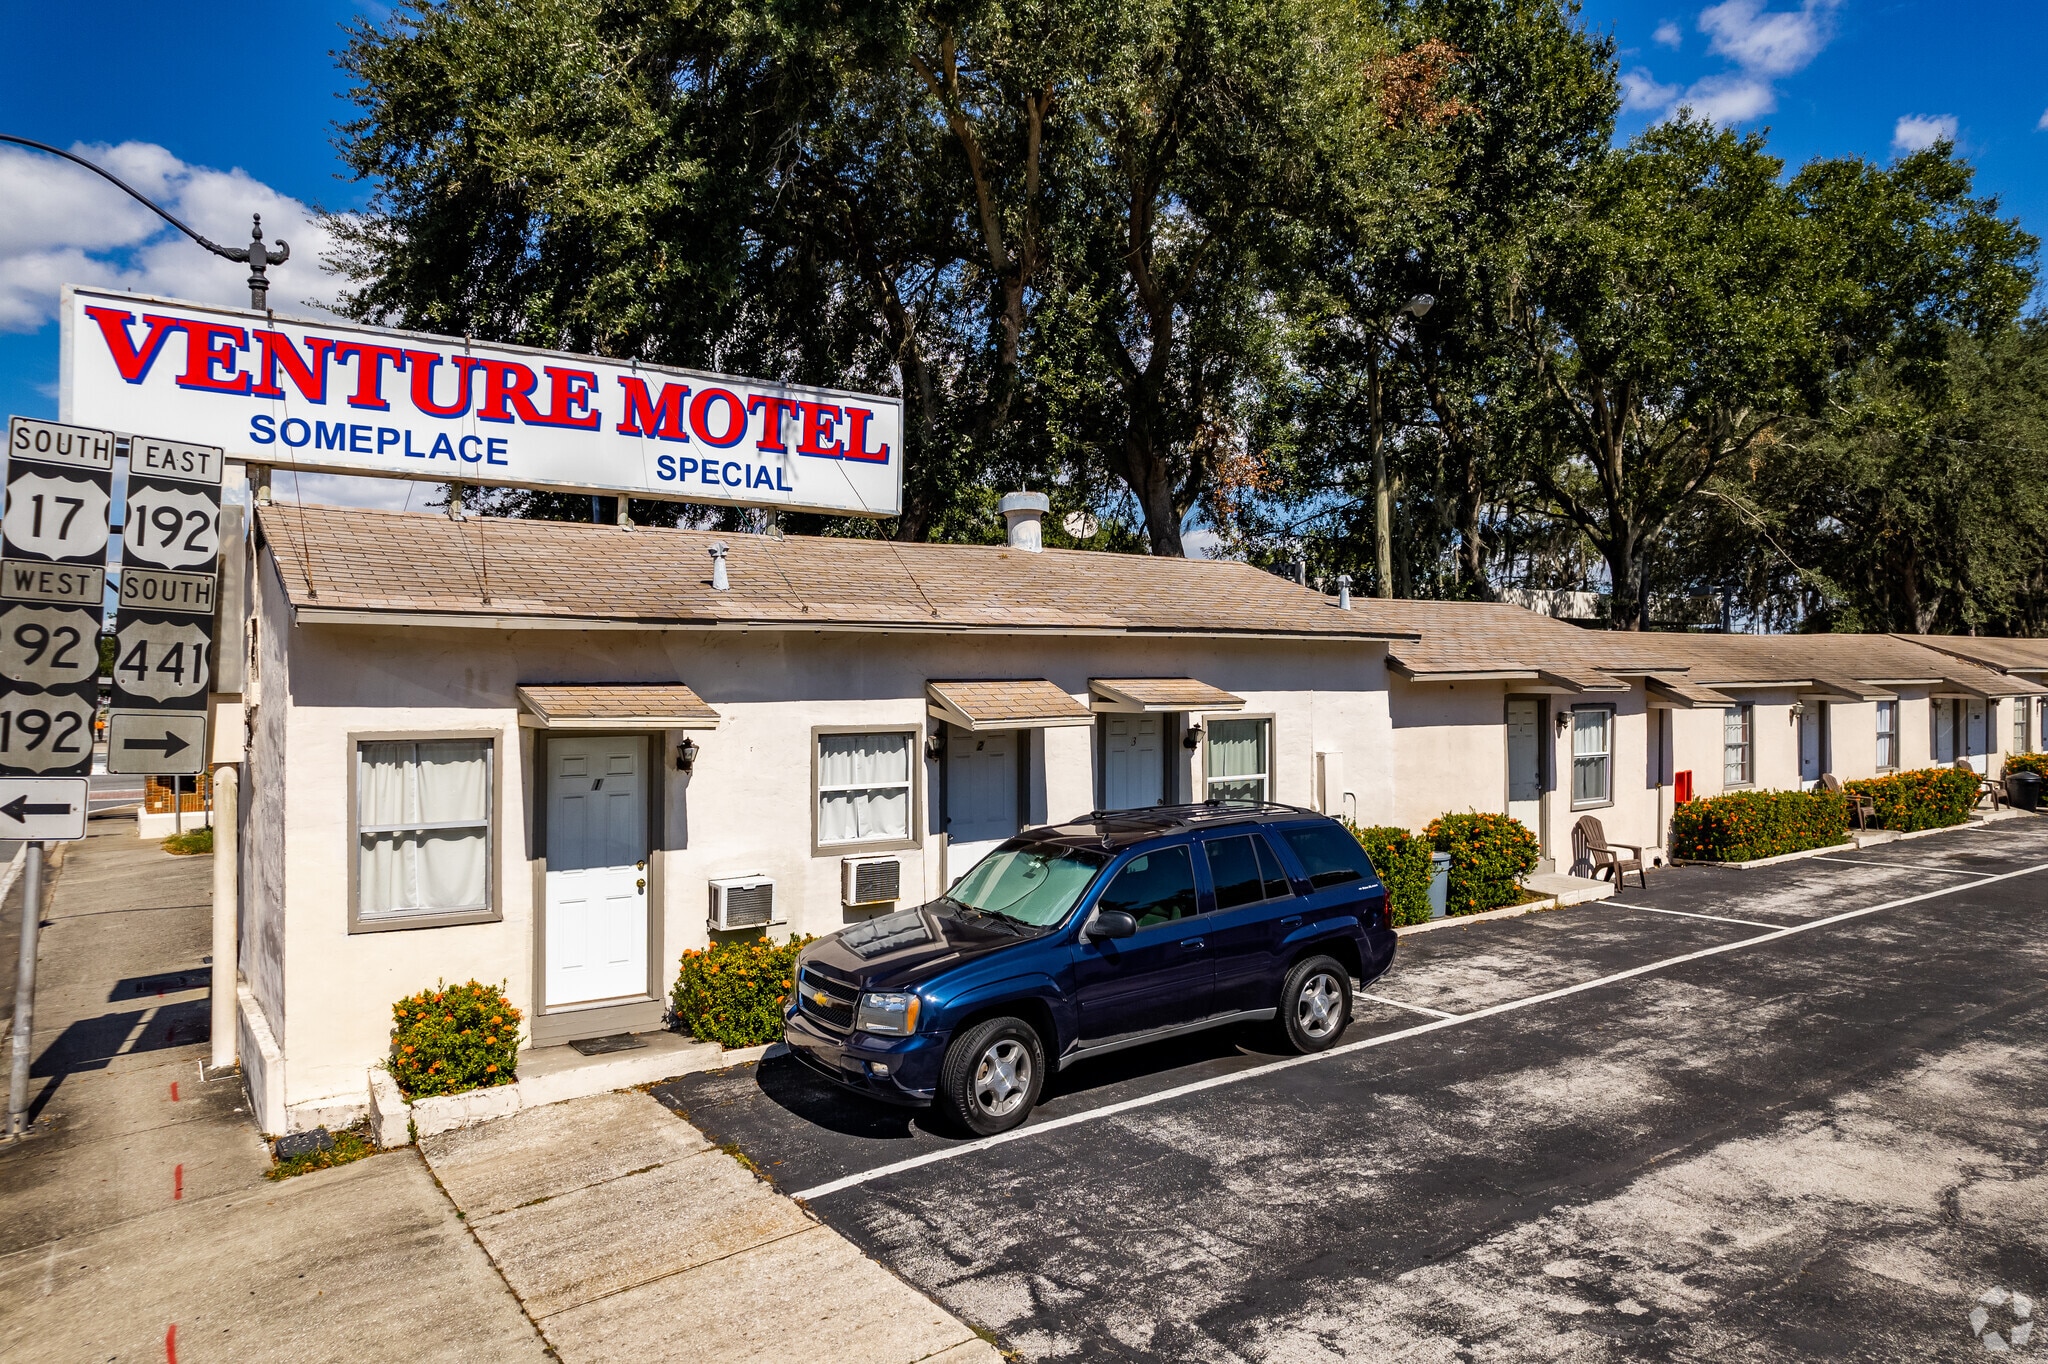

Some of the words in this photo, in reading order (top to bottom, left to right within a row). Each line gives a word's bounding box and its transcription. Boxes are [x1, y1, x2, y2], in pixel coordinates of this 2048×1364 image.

[84, 305, 603, 433] VENTURE
[616, 375, 891, 465] MOTEL
[14, 426, 109, 461] SOUTH
[146, 445, 210, 474] EAST
[249, 414, 508, 466] SOMEPLACE
[656, 454, 793, 492] SPECIAL
[32, 494, 84, 540] 17
[136, 505, 211, 553] 192
[13, 569, 91, 596] WEST
[124, 576, 211, 605] SOUTH
[13, 622, 81, 669] 92
[118, 639, 203, 685] 441
[0, 708, 83, 753] 192
